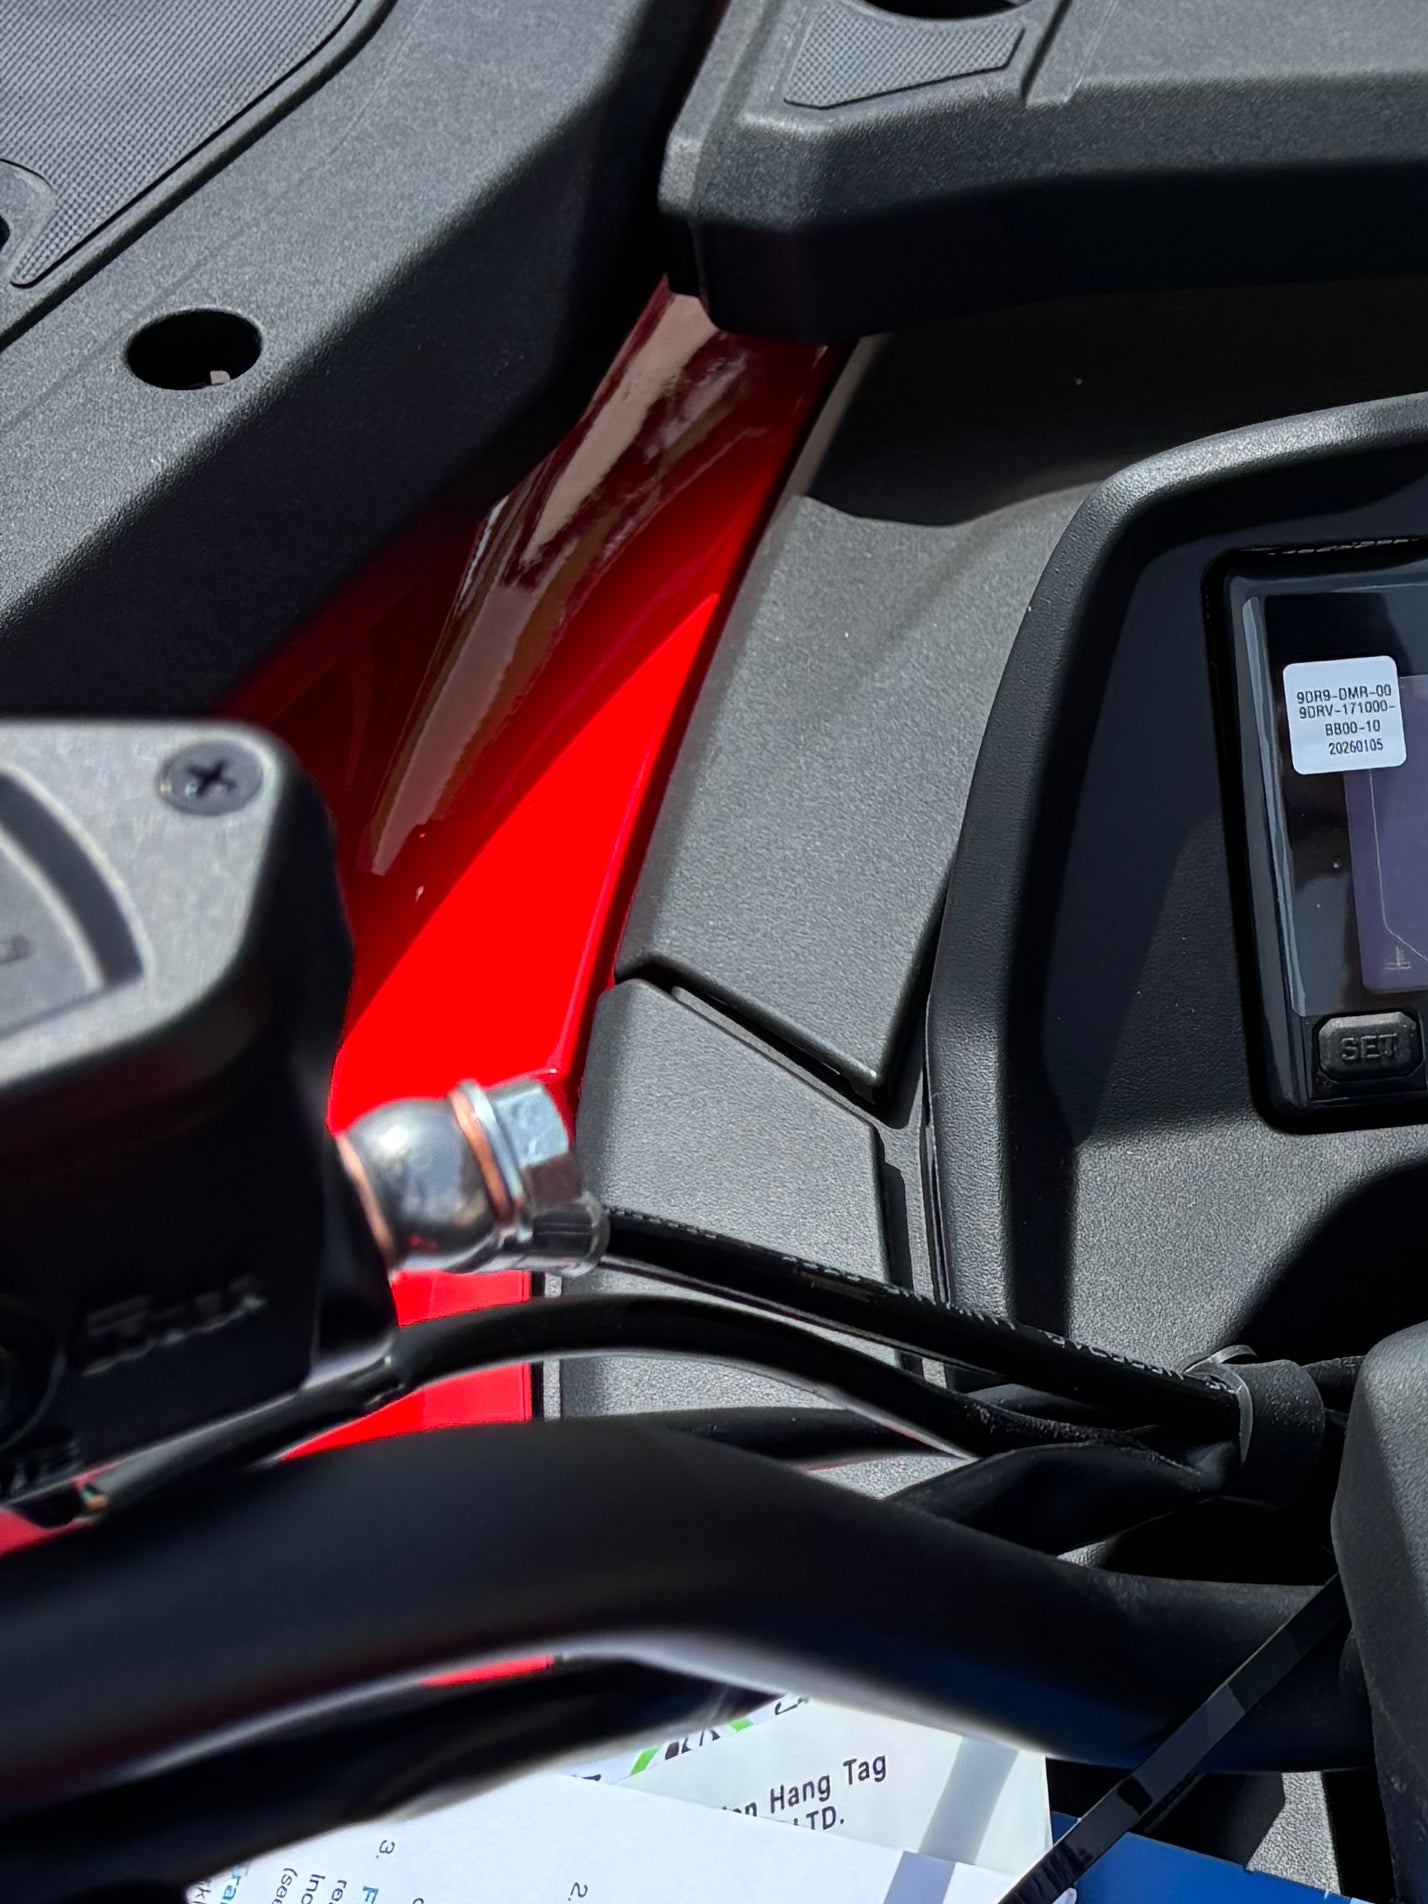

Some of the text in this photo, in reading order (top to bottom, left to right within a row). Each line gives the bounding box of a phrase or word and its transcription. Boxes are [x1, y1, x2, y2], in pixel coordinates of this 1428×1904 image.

[1329, 738, 1384, 755] 20260105
[1340, 1032, 1397, 1062] SET
[770, 1773, 831, 1813] Hang
[843, 1755, 886, 1785] Tag
[375, 1839, 395, 1858] 3.
[567, 1881, 588, 1901] 2.
